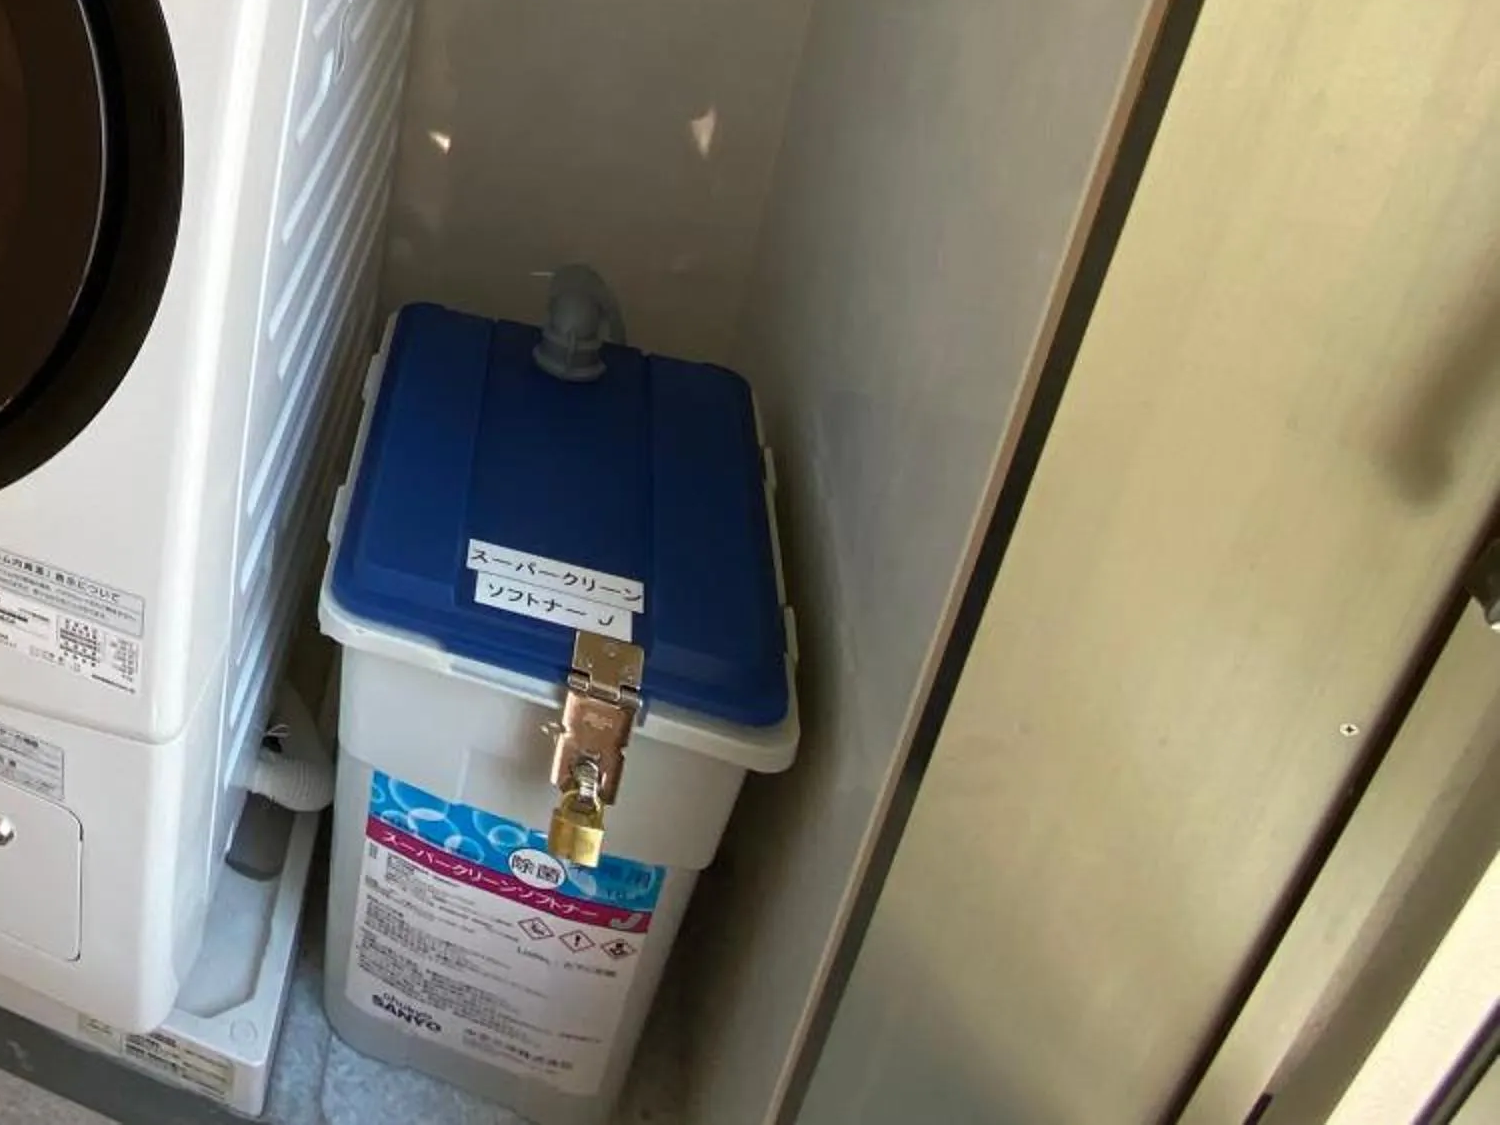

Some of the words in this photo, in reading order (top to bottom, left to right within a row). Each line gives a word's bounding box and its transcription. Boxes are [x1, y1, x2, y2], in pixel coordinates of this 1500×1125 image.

[472, 549, 642, 602] スーパークリーン
[488, 583, 587, 616] ソフトナー
[511, 854, 560, 884] 除菌
